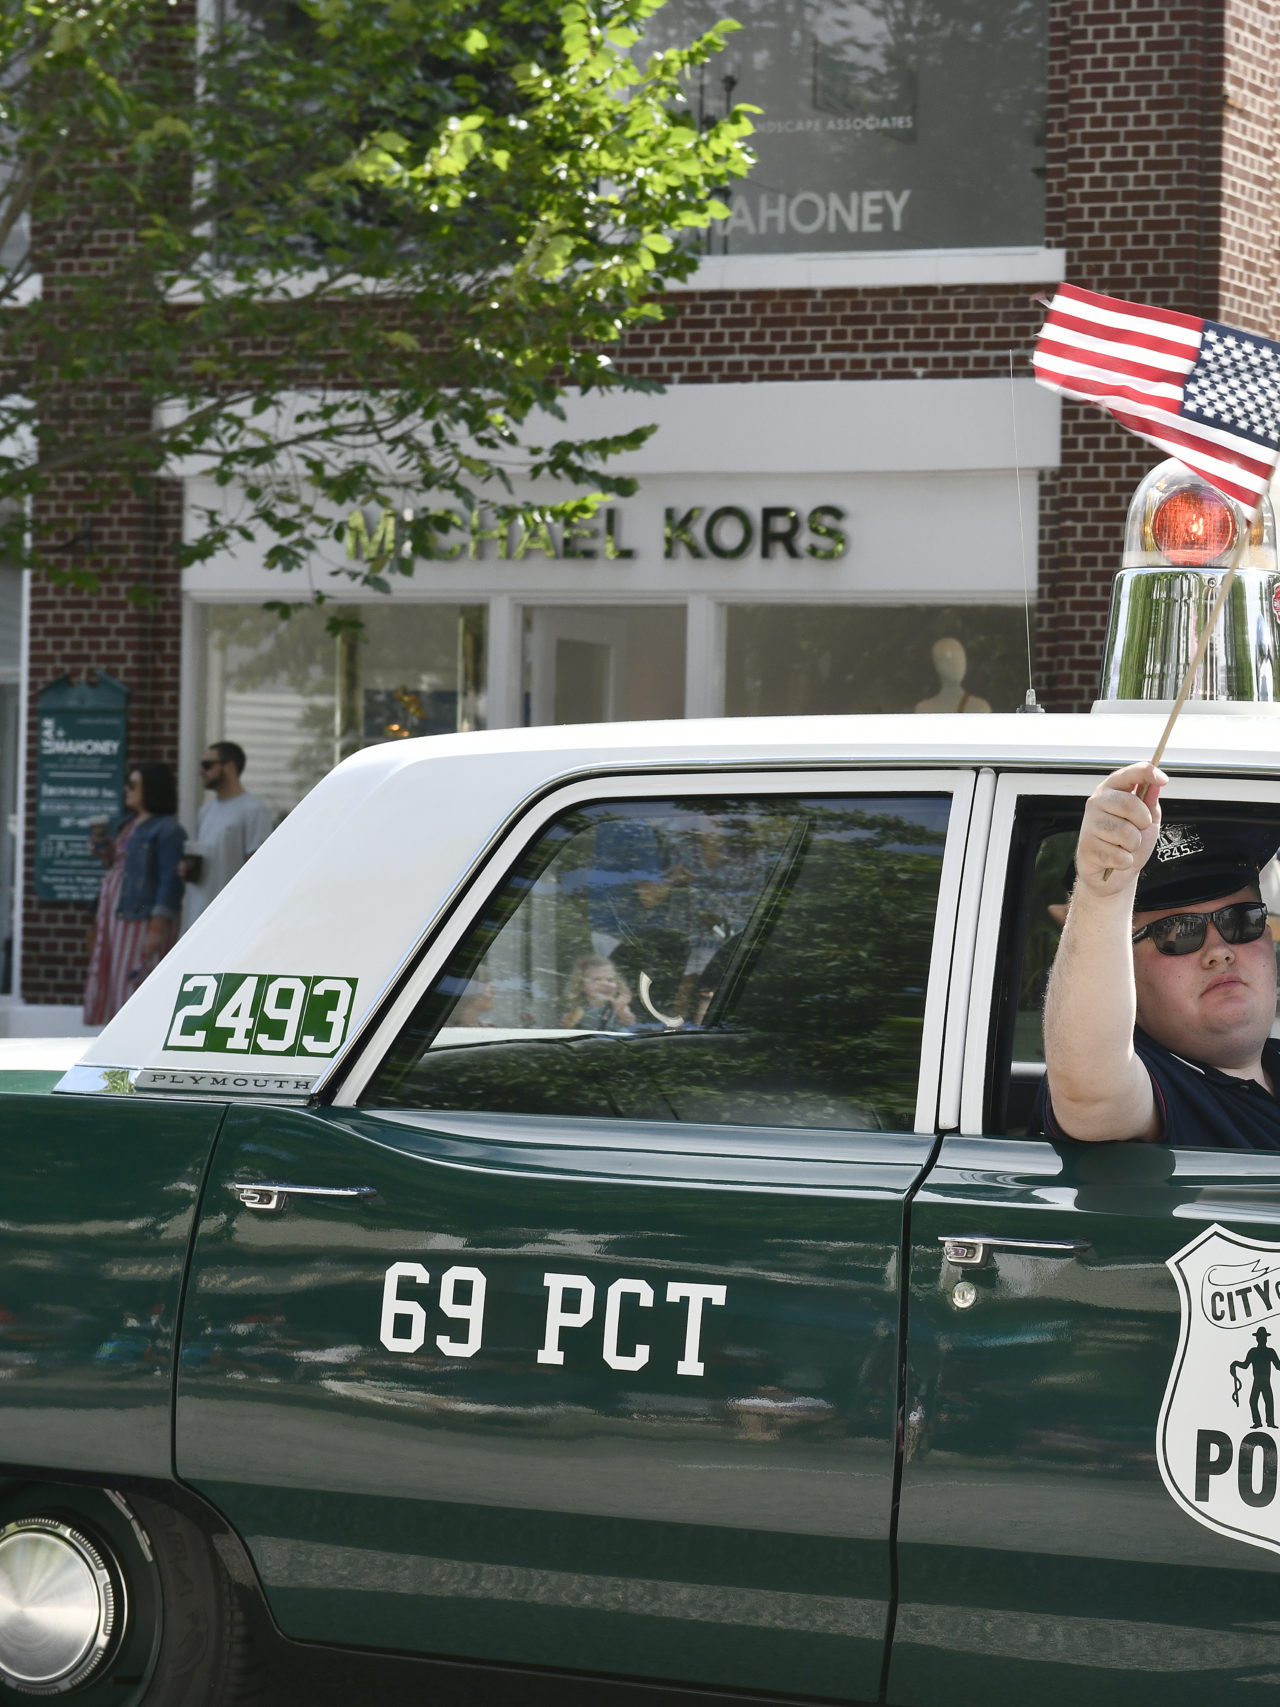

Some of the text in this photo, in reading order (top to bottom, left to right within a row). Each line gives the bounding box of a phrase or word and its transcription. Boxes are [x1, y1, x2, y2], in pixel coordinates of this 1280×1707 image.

[756, 115, 914, 133] NDSCAPE ASSOCIATES
[713, 189, 912, 236] AHONEY
[346, 505, 847, 560] MCHAEL KORS
[166, 975, 353, 1054] 2493
[151, 1074, 311, 1090] PLYMOUTH
[379, 1261, 728, 1377] 69 PCT
[1210, 1279, 1273, 1322] CITY
